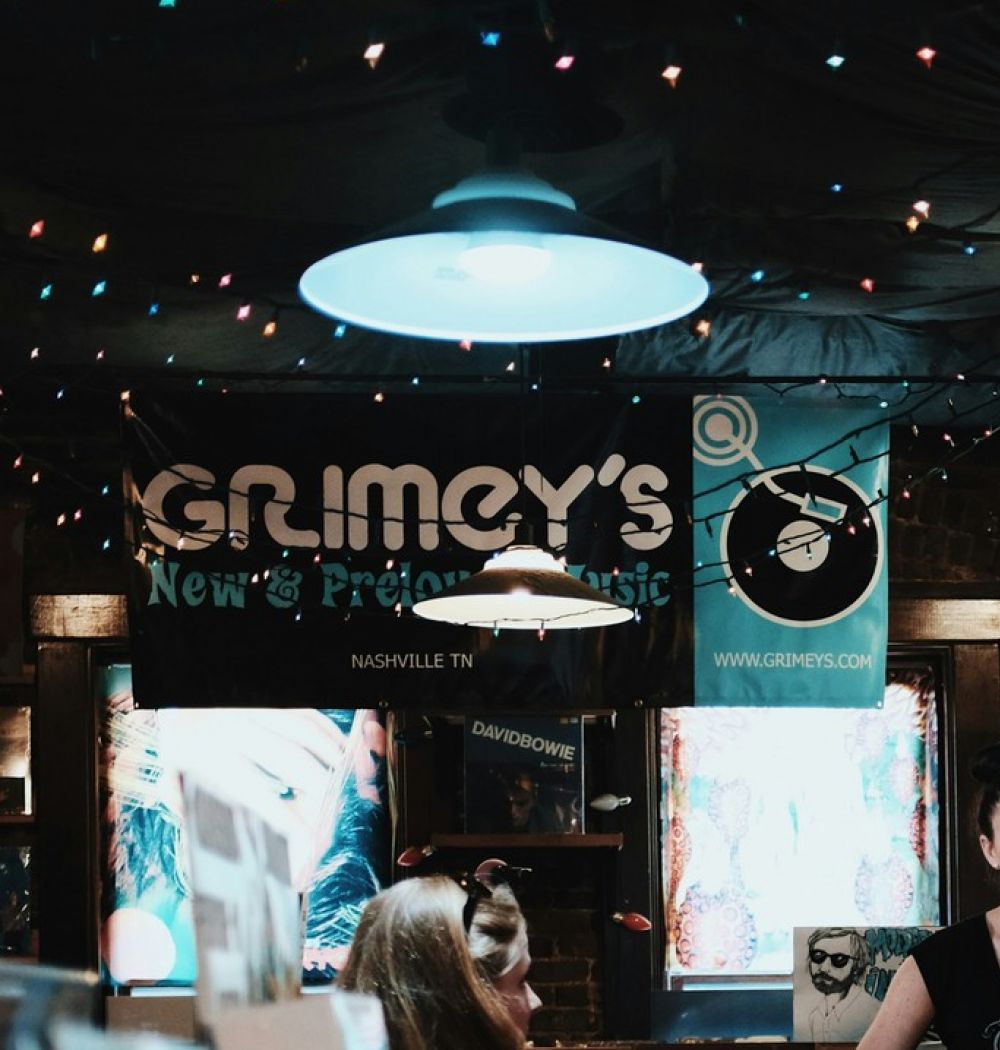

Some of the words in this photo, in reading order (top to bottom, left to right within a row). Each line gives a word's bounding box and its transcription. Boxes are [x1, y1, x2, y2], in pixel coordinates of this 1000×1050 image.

[142, 453, 674, 551] GRIMEY'S
[147, 562, 247, 609] New
[265, 564, 302, 608] &
[352, 653, 444, 669] NASHVILLE
[452, 653, 474, 669] TN
[713, 652, 873, 669] WWW.GRIMEYS.COM
